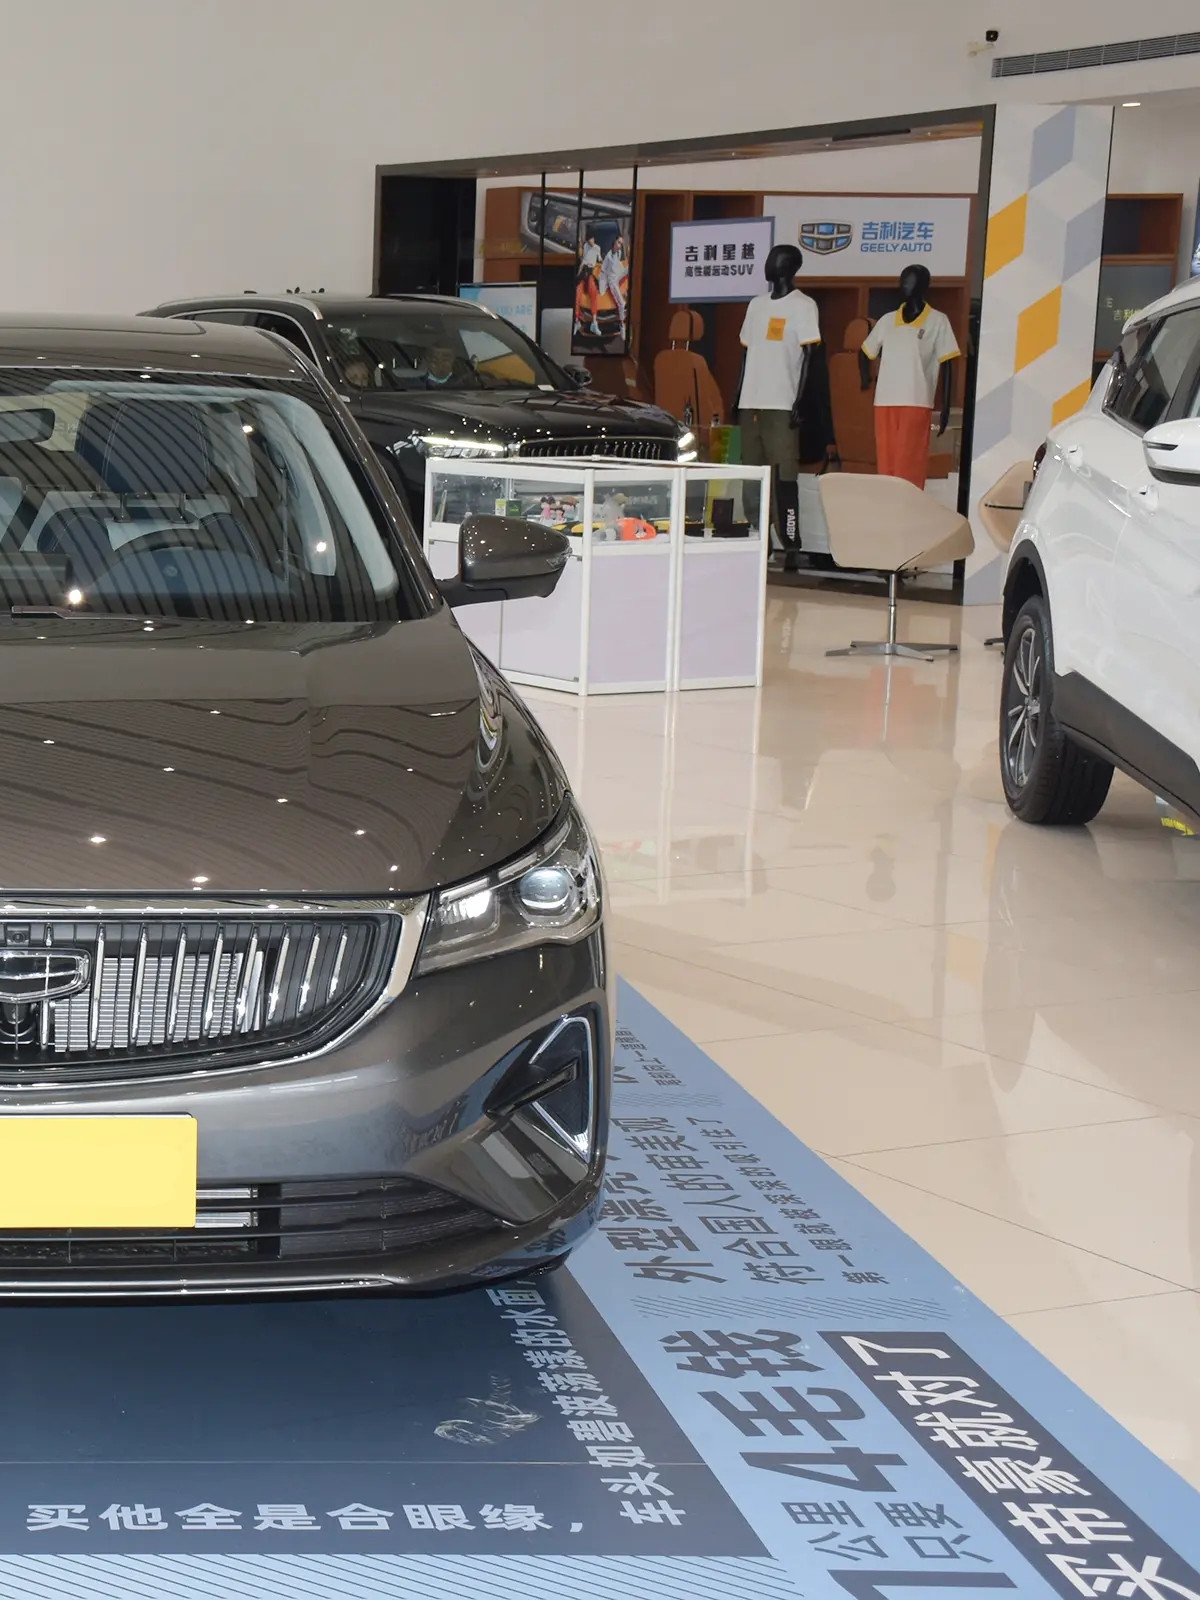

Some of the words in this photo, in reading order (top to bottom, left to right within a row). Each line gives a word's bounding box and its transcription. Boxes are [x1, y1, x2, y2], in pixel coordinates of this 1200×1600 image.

[685, 243, 754, 262] 吉利星越
[860, 242, 899, 252] GEELY
[900, 242, 932, 252] AUTO
[861, 221, 934, 240] 吉利汽车
[610, 1116, 825, 1284] 符合国人的审美观
[686, 1116, 890, 1284] 第一眼就被深深的吸引住了
[657, 1328, 908, 1492] 4毛钱
[840, 1335, 1200, 1600] 买帝豪就对了
[781, 1500, 889, 1562] 公里
[875, 1501, 995, 1563] 只要
